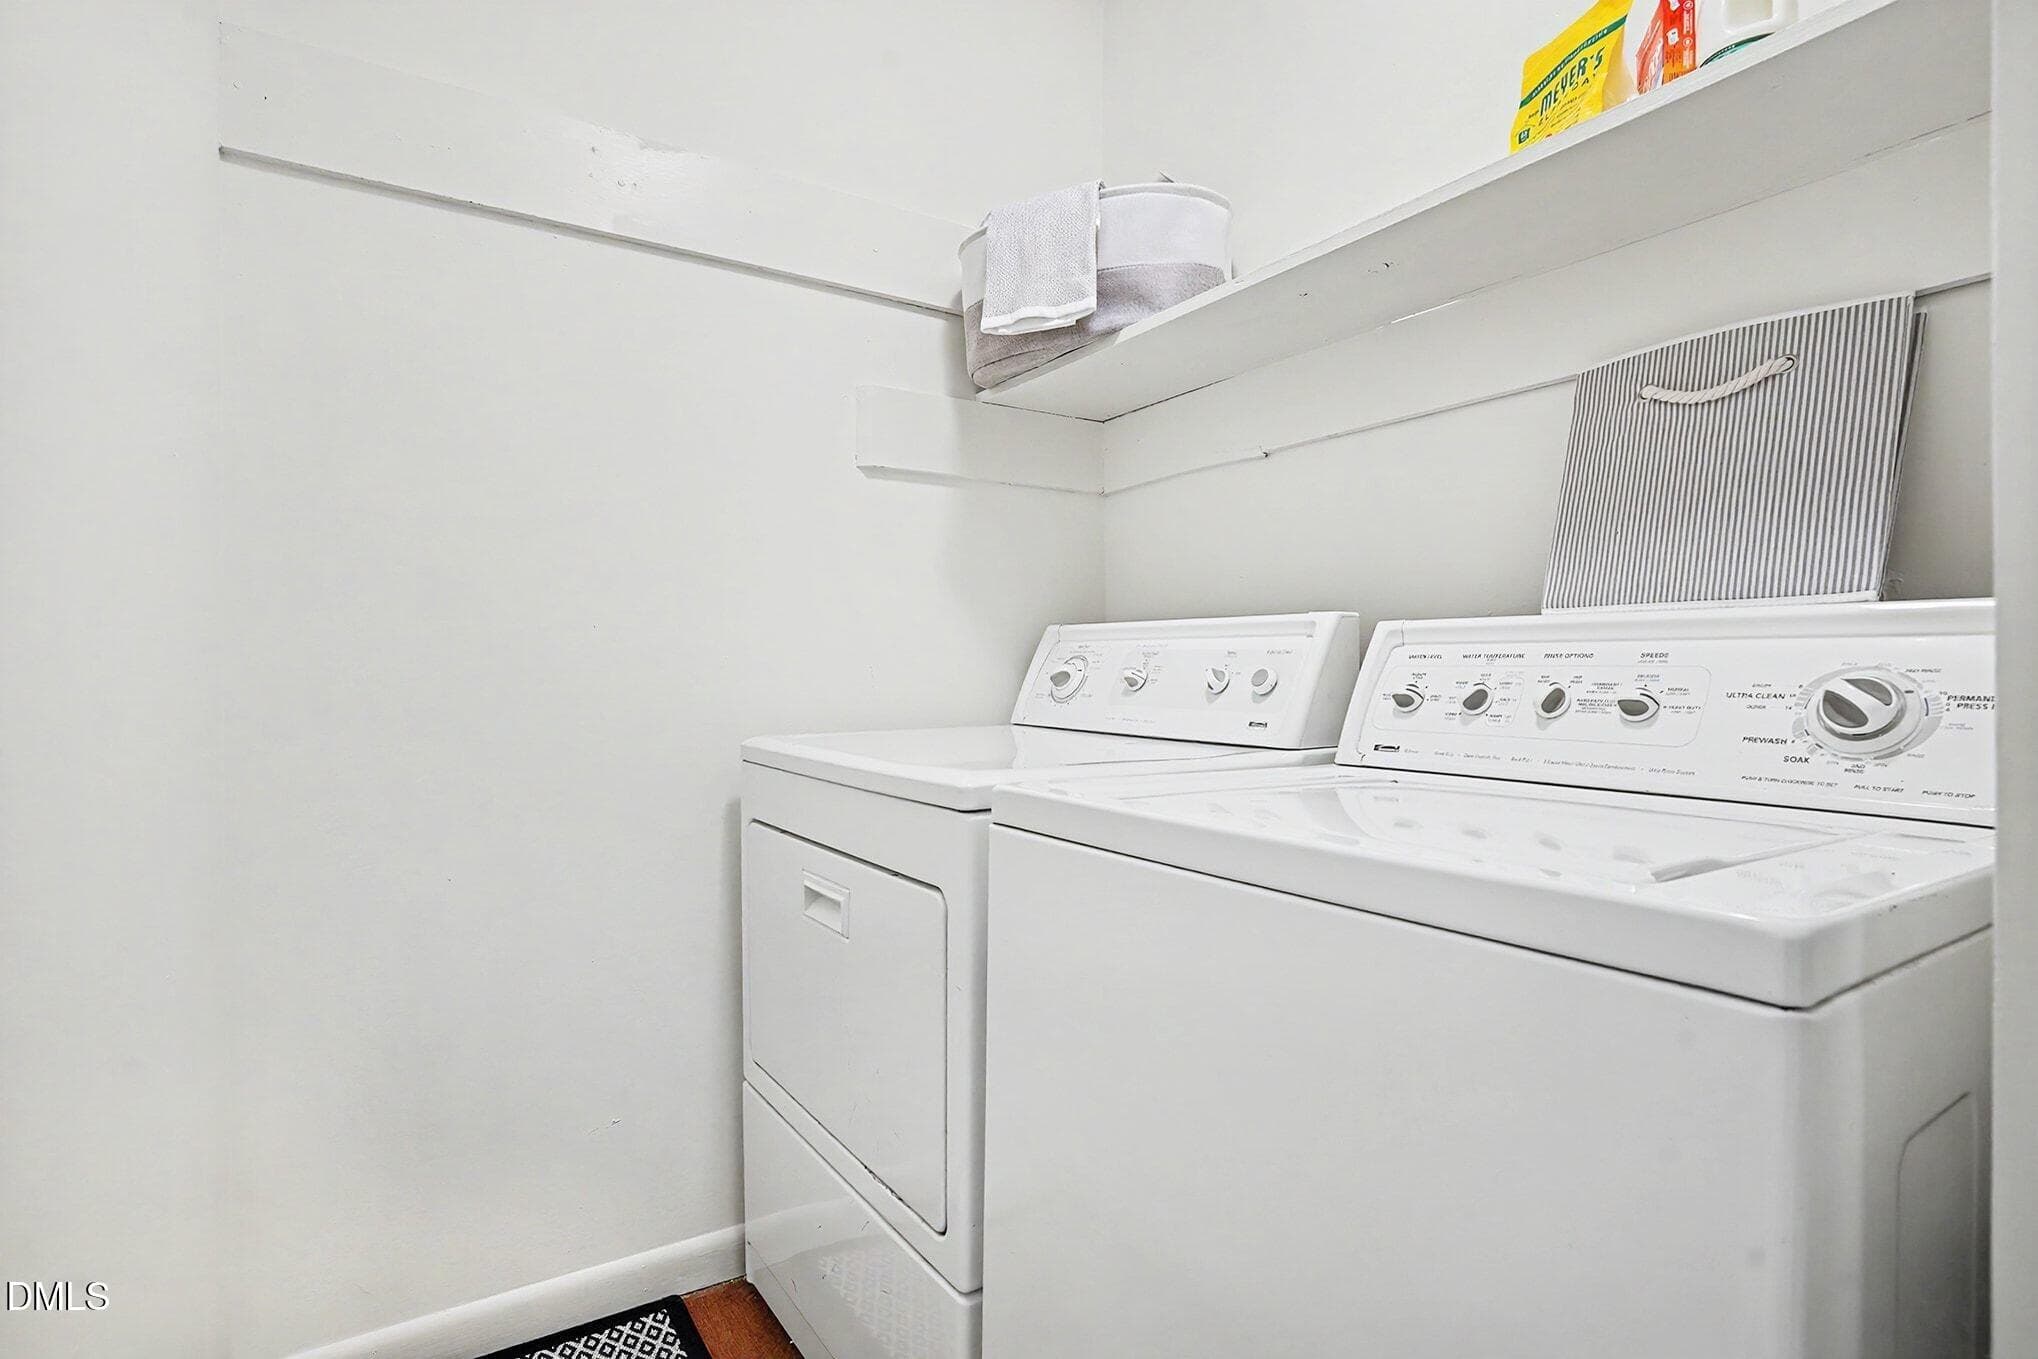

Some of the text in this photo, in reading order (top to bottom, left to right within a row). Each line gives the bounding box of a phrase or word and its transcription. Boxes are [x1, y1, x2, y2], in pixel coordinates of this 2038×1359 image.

[1540, 45, 1605, 117] MEYER'S
[1564, 652, 1595, 660] OPTIONS
[1640, 651, 1670, 660] SPEEDS
[1726, 691, 1754, 699] ULTRA
[1755, 692, 1786, 700] CLEAN
[1956, 702, 1990, 710] PRESS
[1741, 736, 1788, 745] PREWASH
[1783, 755, 1811, 764] SOAK
[1882, 786, 1905, 794] START
